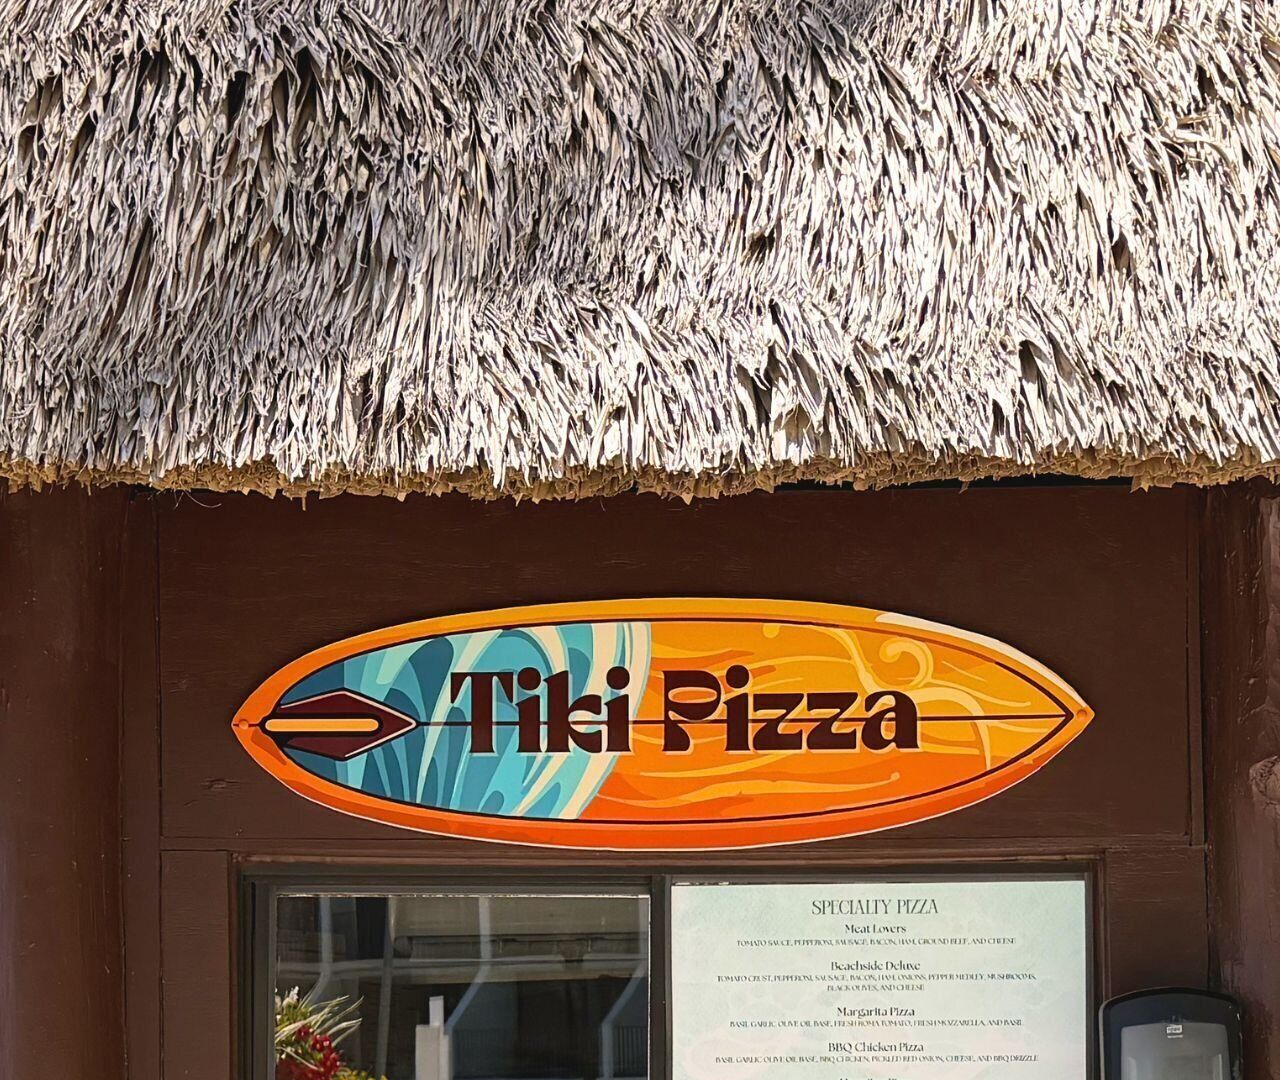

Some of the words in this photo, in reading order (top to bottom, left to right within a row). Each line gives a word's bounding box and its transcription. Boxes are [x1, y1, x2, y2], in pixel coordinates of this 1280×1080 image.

[449, 666, 632, 755] Tiki
[661, 663, 921, 754] Pizza
[811, 899, 892, 915] SPECIALTY
[897, 898, 939, 915] PIZZA
[844, 924, 871, 934] Meat
[873, 924, 908, 934] Lovers
[831, 961, 883, 971] Beachside
[885, 960, 921, 971] Deluxe
[837, 1007, 888, 1019] Margarita
[890, 1007, 915, 1016] Pizza
[828, 1042, 852, 1054] BBQ
[855, 1042, 897, 1052] Chicken
[899, 1042, 924, 1052] Pizza
